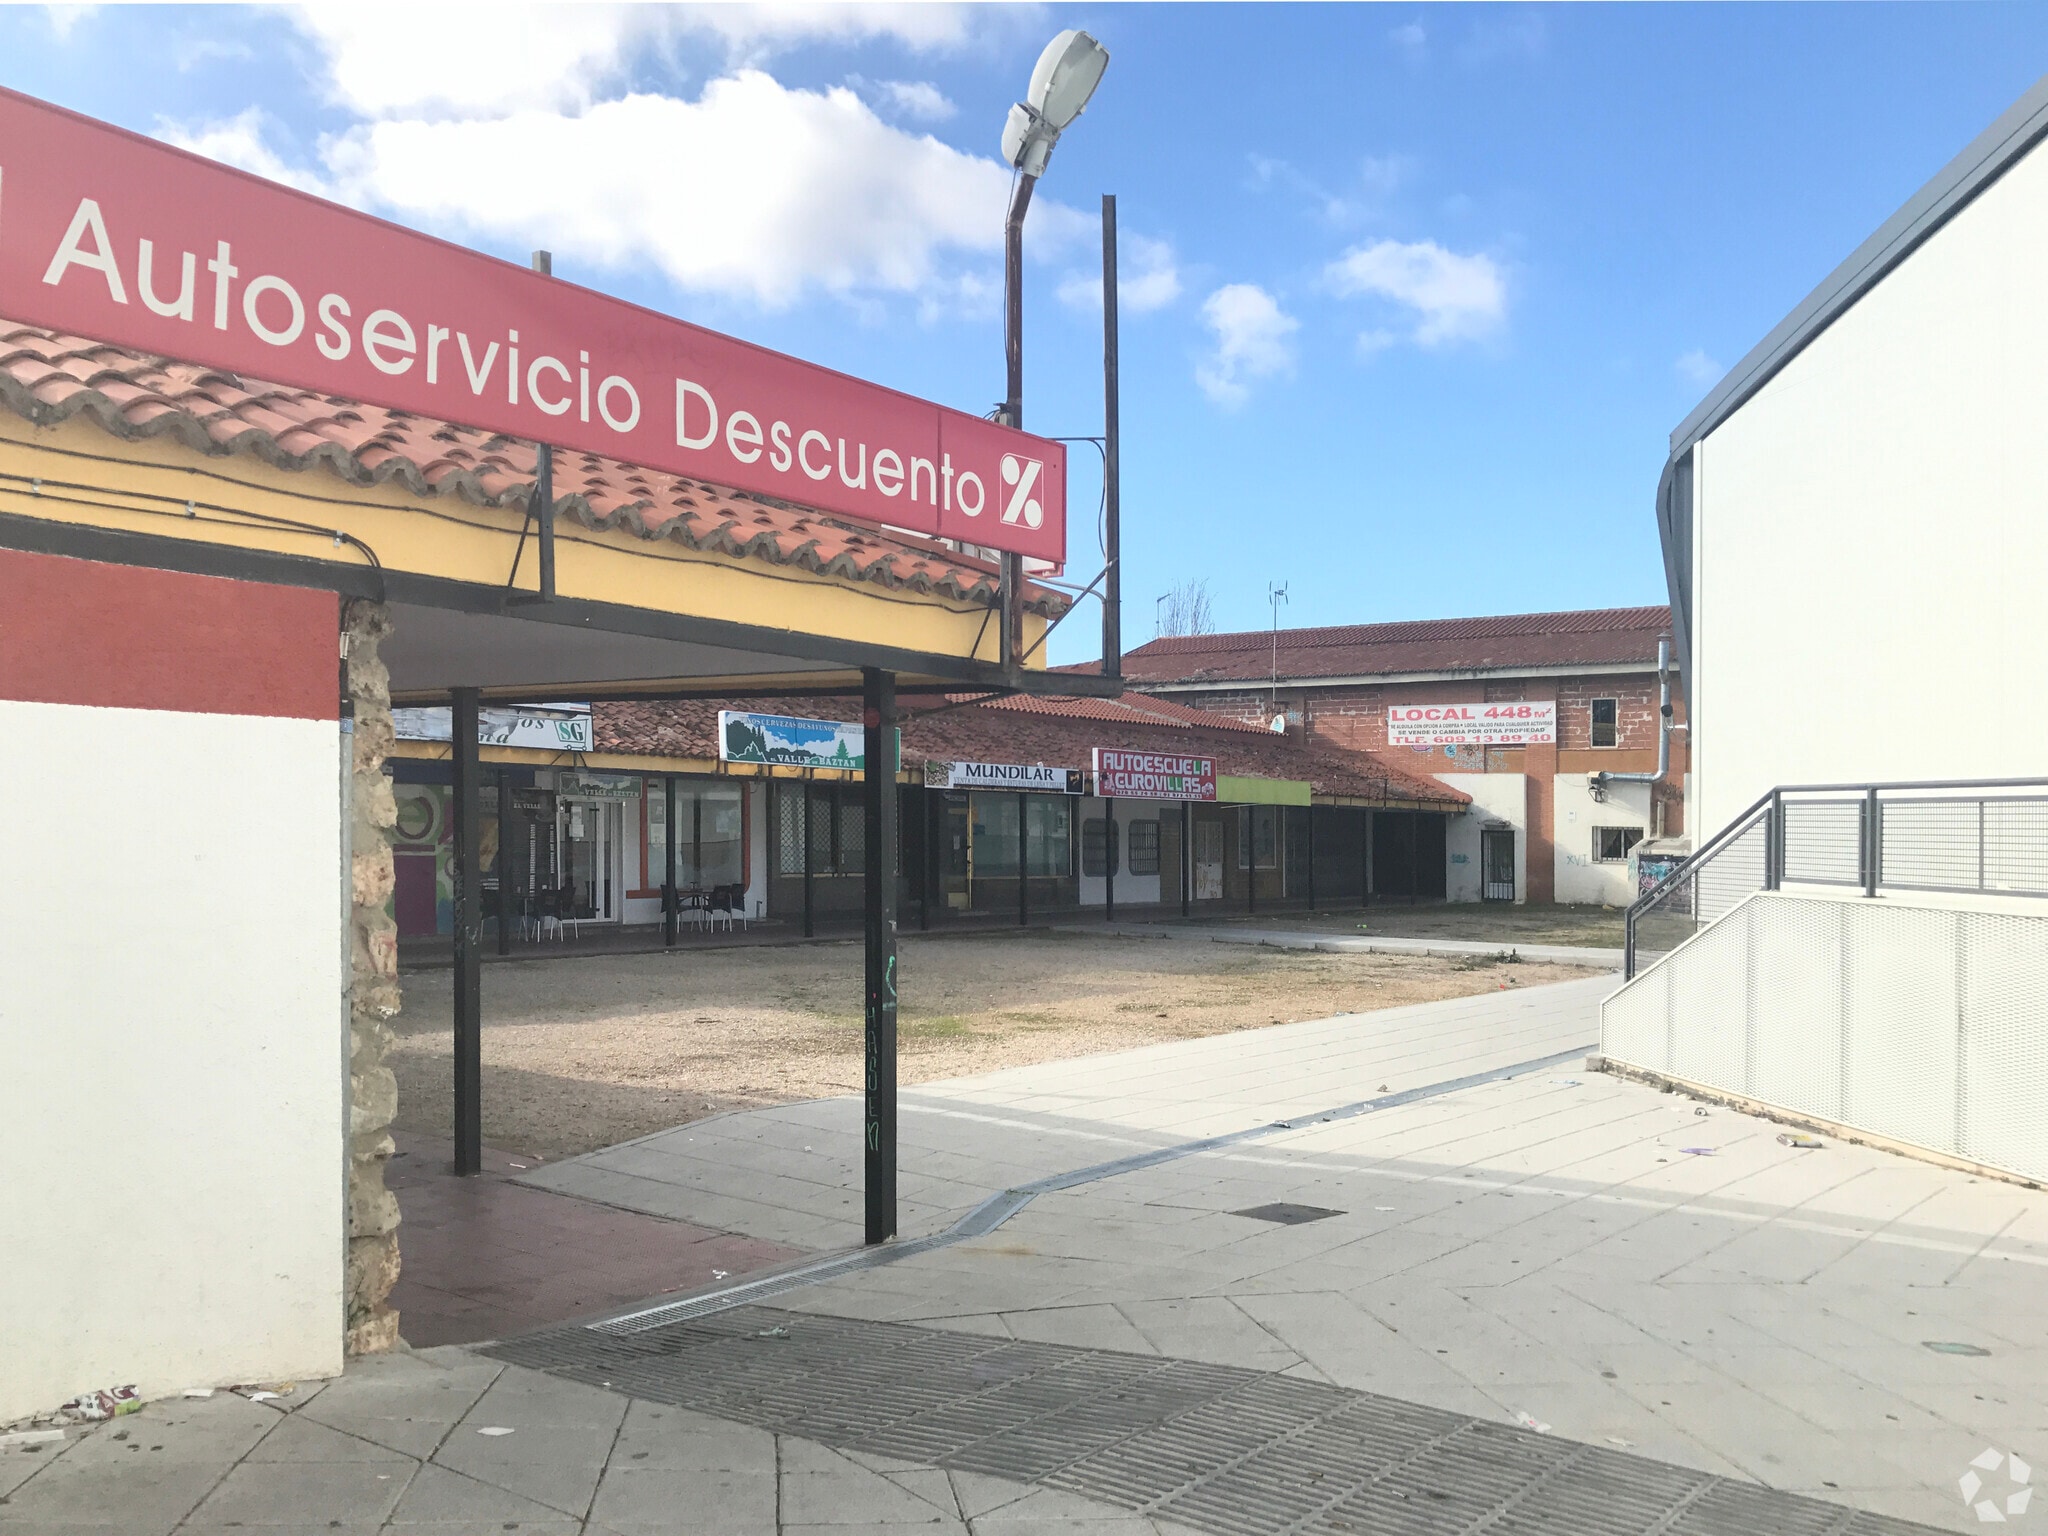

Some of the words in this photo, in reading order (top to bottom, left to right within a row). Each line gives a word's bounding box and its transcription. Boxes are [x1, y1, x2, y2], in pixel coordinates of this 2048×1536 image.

[42, 197, 641, 433] Autoservicio
[675, 378, 985, 517] Descuento
[1391, 708, 1476, 722] LOCAL
[1483, 706, 1532, 719] 448
[559, 721, 584, 742] SG
[761, 718, 797, 729] CERVEZAS
[797, 722, 836, 732] DESAYUNOS
[1433, 735, 1466, 743] 609
[1472, 735, 1493, 743] 13
[1500, 734, 1522, 742] 89
[1528, 734, 1551, 742] 40
[777, 754, 810, 765] VALLE
[820, 756, 856, 768] BAZTAN
[1103, 752, 1211, 777] AUTOESCUELA
[965, 763, 1054, 781] MUNDILAR
[1115, 772, 1201, 793] EUROVILLAS
